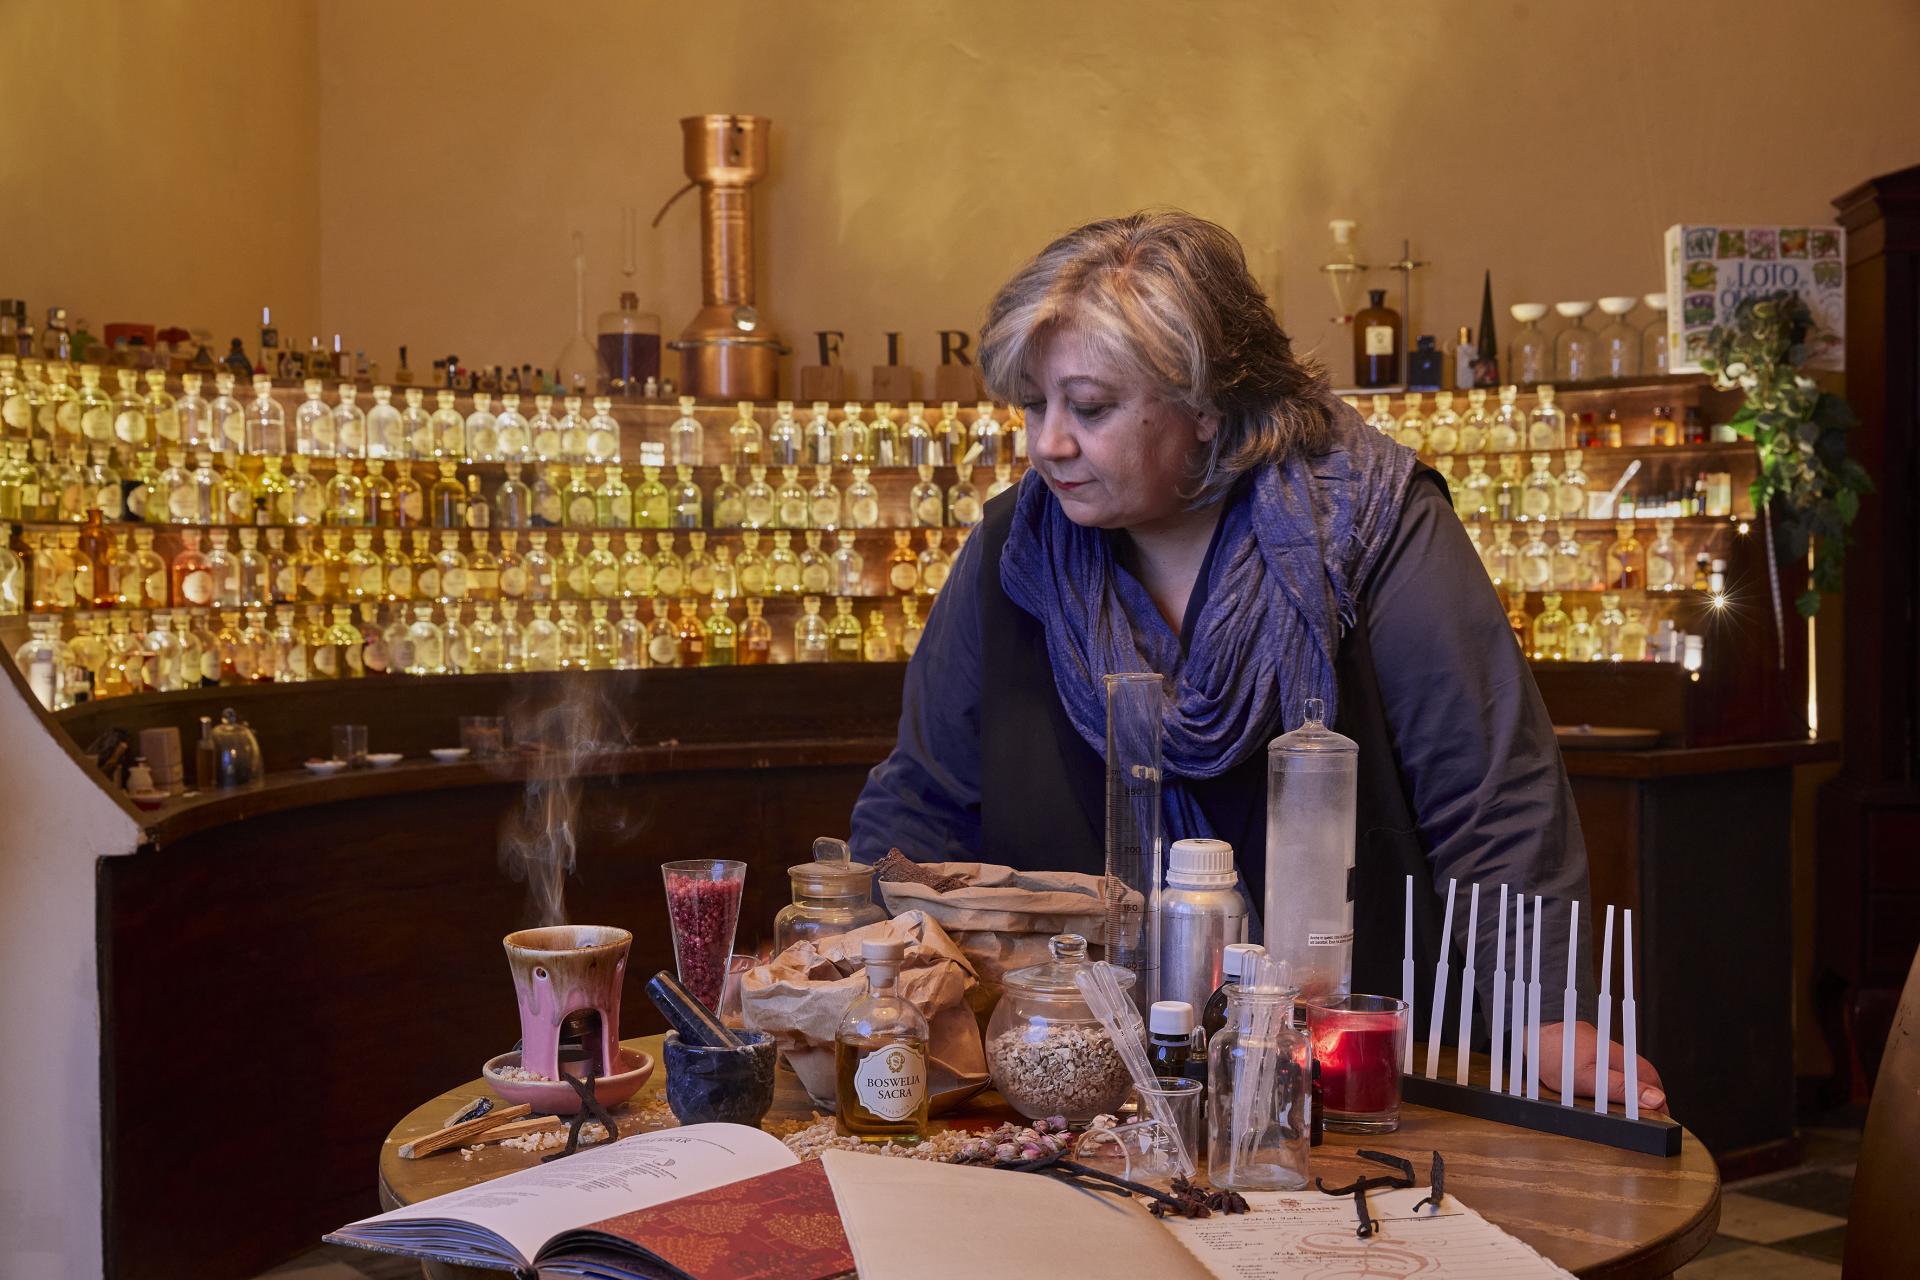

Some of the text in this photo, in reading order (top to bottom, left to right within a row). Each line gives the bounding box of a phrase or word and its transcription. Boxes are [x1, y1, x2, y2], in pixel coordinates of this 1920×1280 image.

[1123, 904, 1138, 912] 150
[867, 1075, 921, 1088] BOSWELIA
[877, 1088, 913, 1100] SACRA
